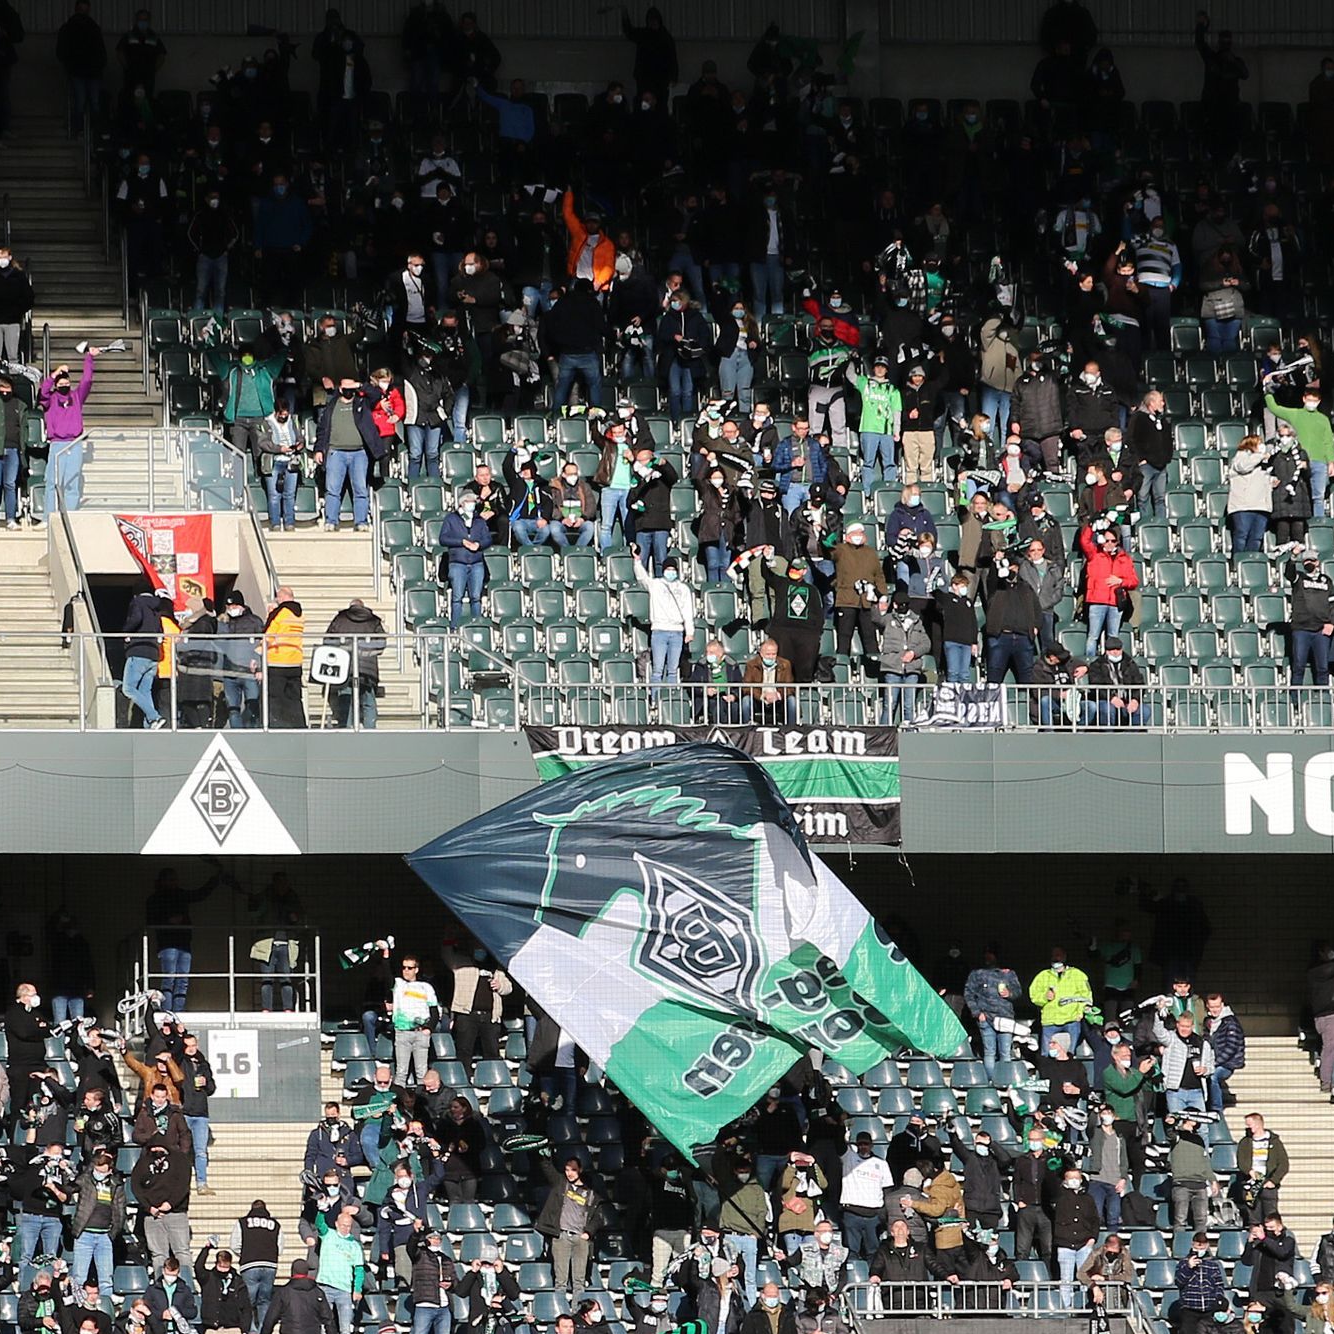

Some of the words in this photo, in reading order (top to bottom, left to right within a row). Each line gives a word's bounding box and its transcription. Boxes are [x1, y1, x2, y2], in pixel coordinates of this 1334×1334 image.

[755, 726, 867, 755] Team
[216, 1052, 251, 1075] 16
[246, 1217, 276, 1231] 1900
